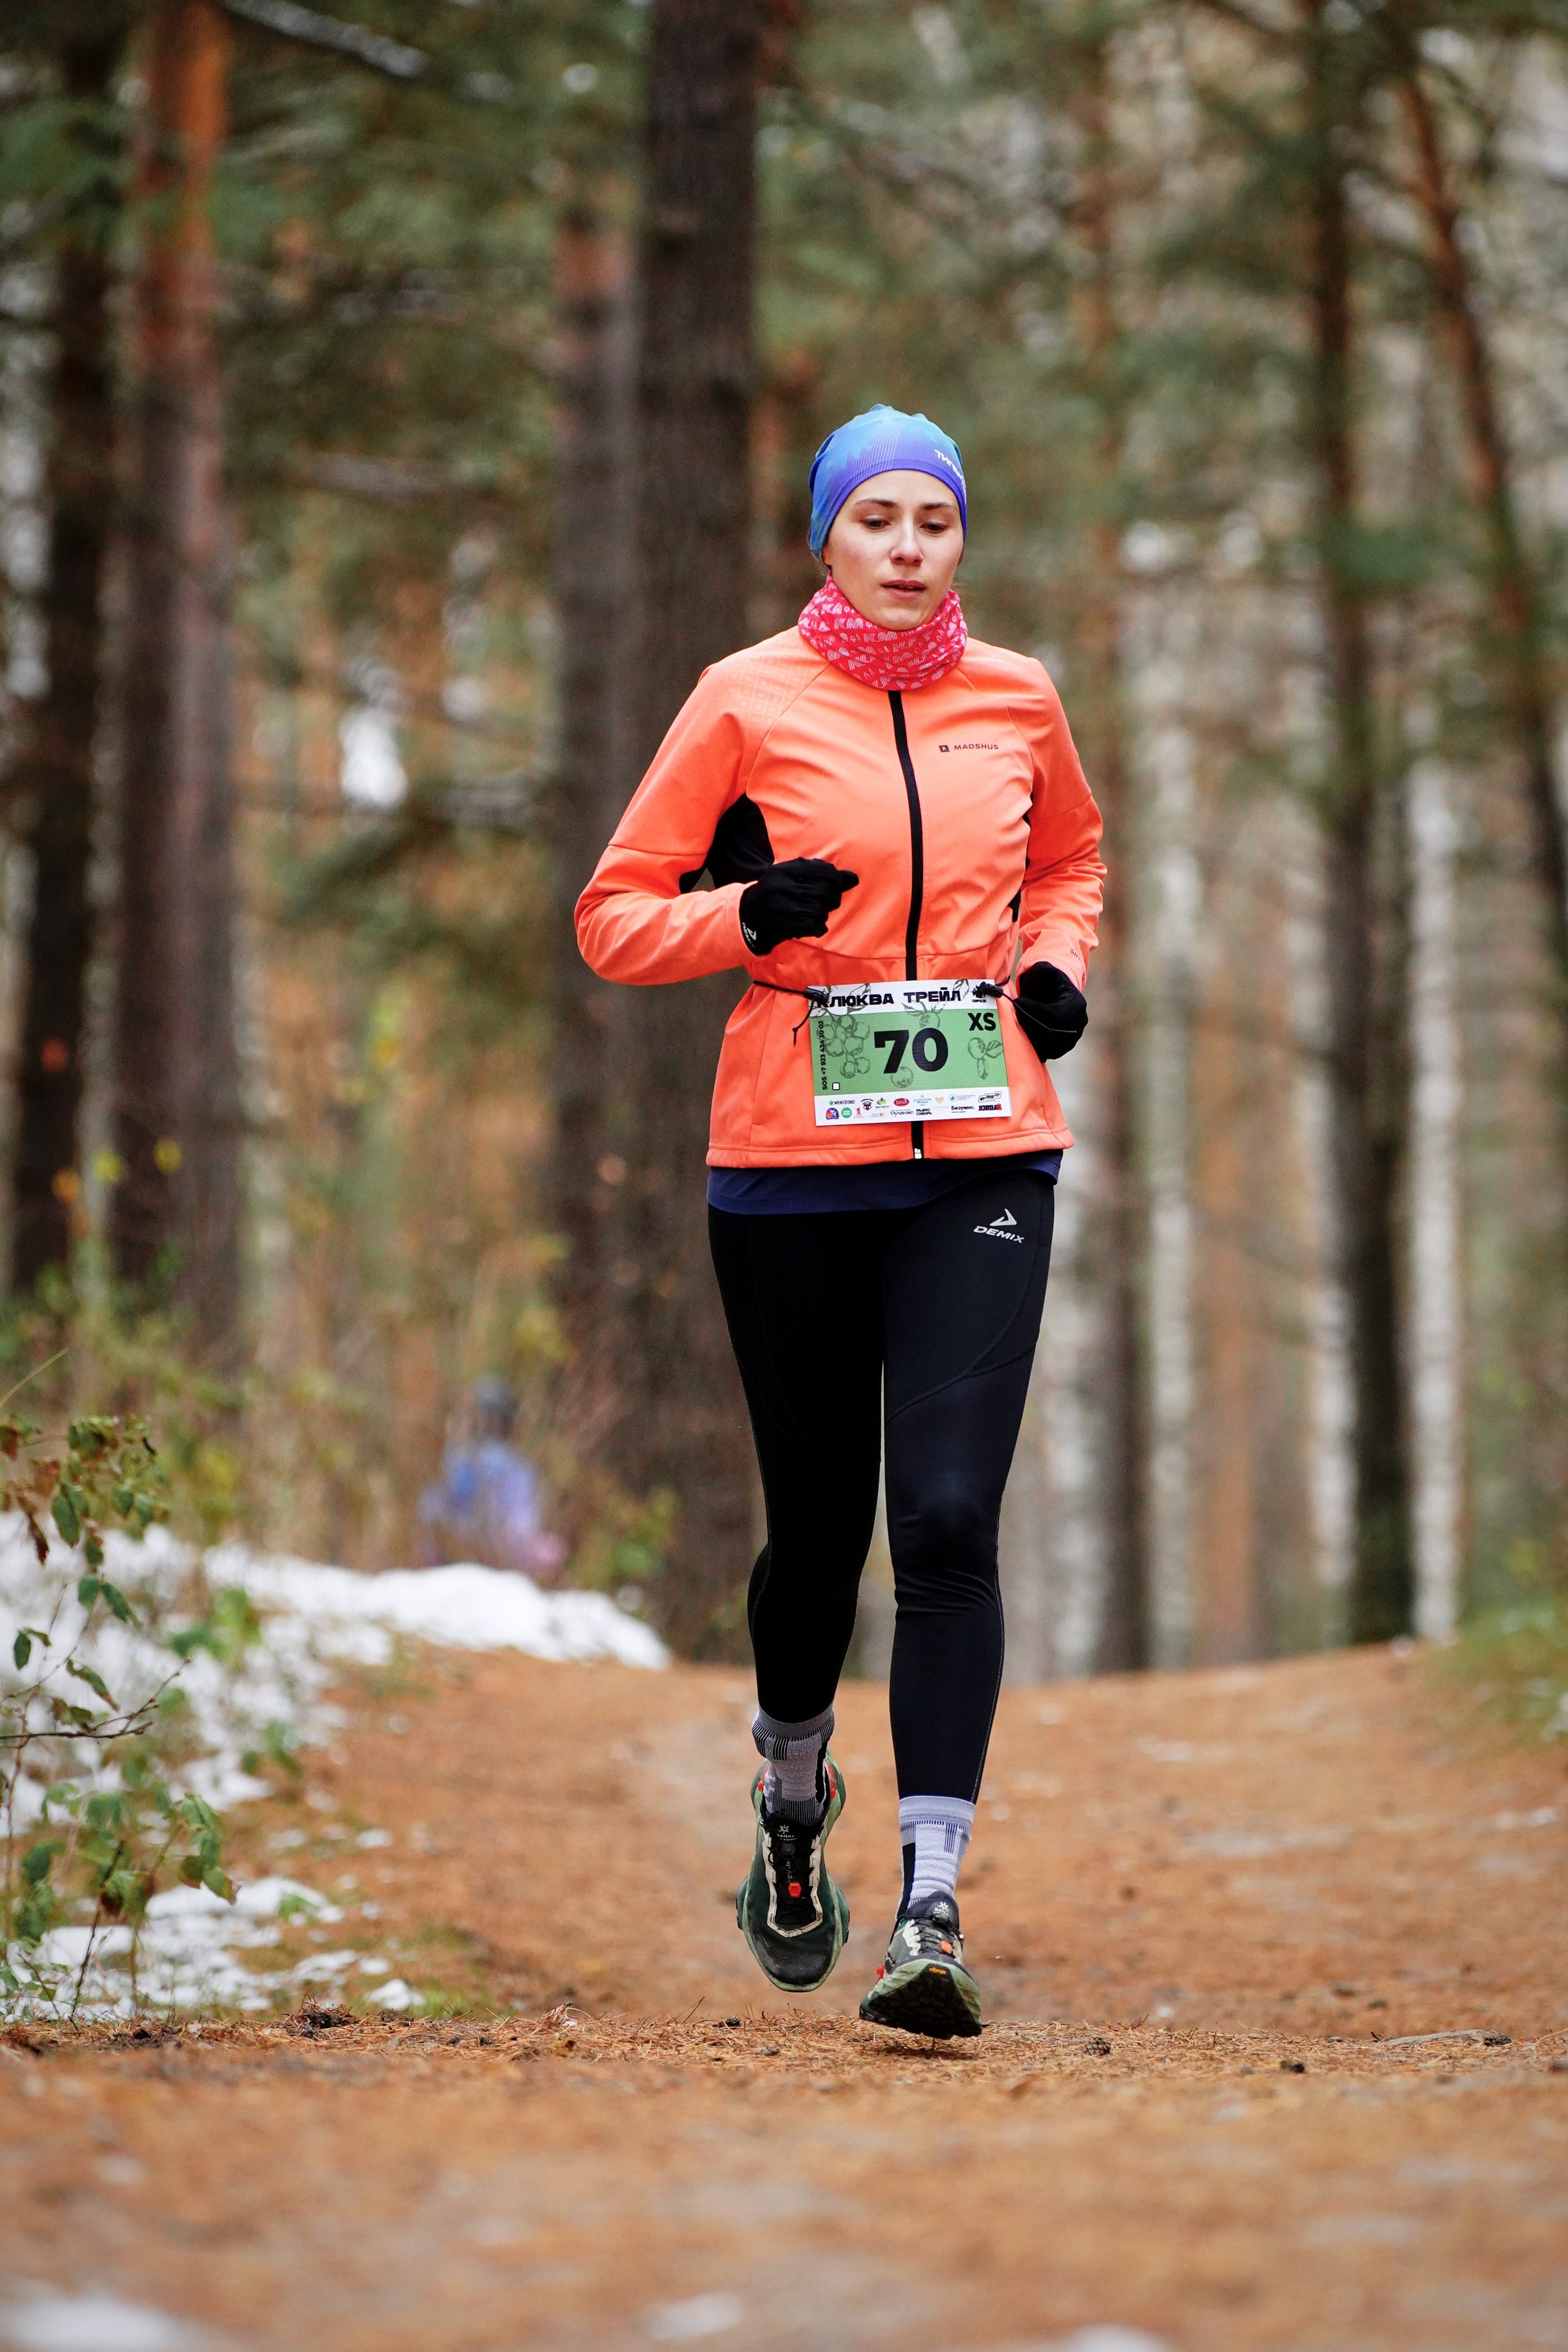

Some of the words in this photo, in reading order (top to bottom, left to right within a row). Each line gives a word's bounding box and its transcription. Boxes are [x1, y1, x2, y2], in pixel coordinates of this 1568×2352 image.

[903, 987, 961, 1003] ТРЕЙЛ
[818, 1020, 824, 1029] 02
[968, 1012, 997, 1031] XS
[819, 1031, 825, 1040] 30
[874, 1028, 948, 1074] 70
[973, 1226, 1025, 1243] DEMIX
